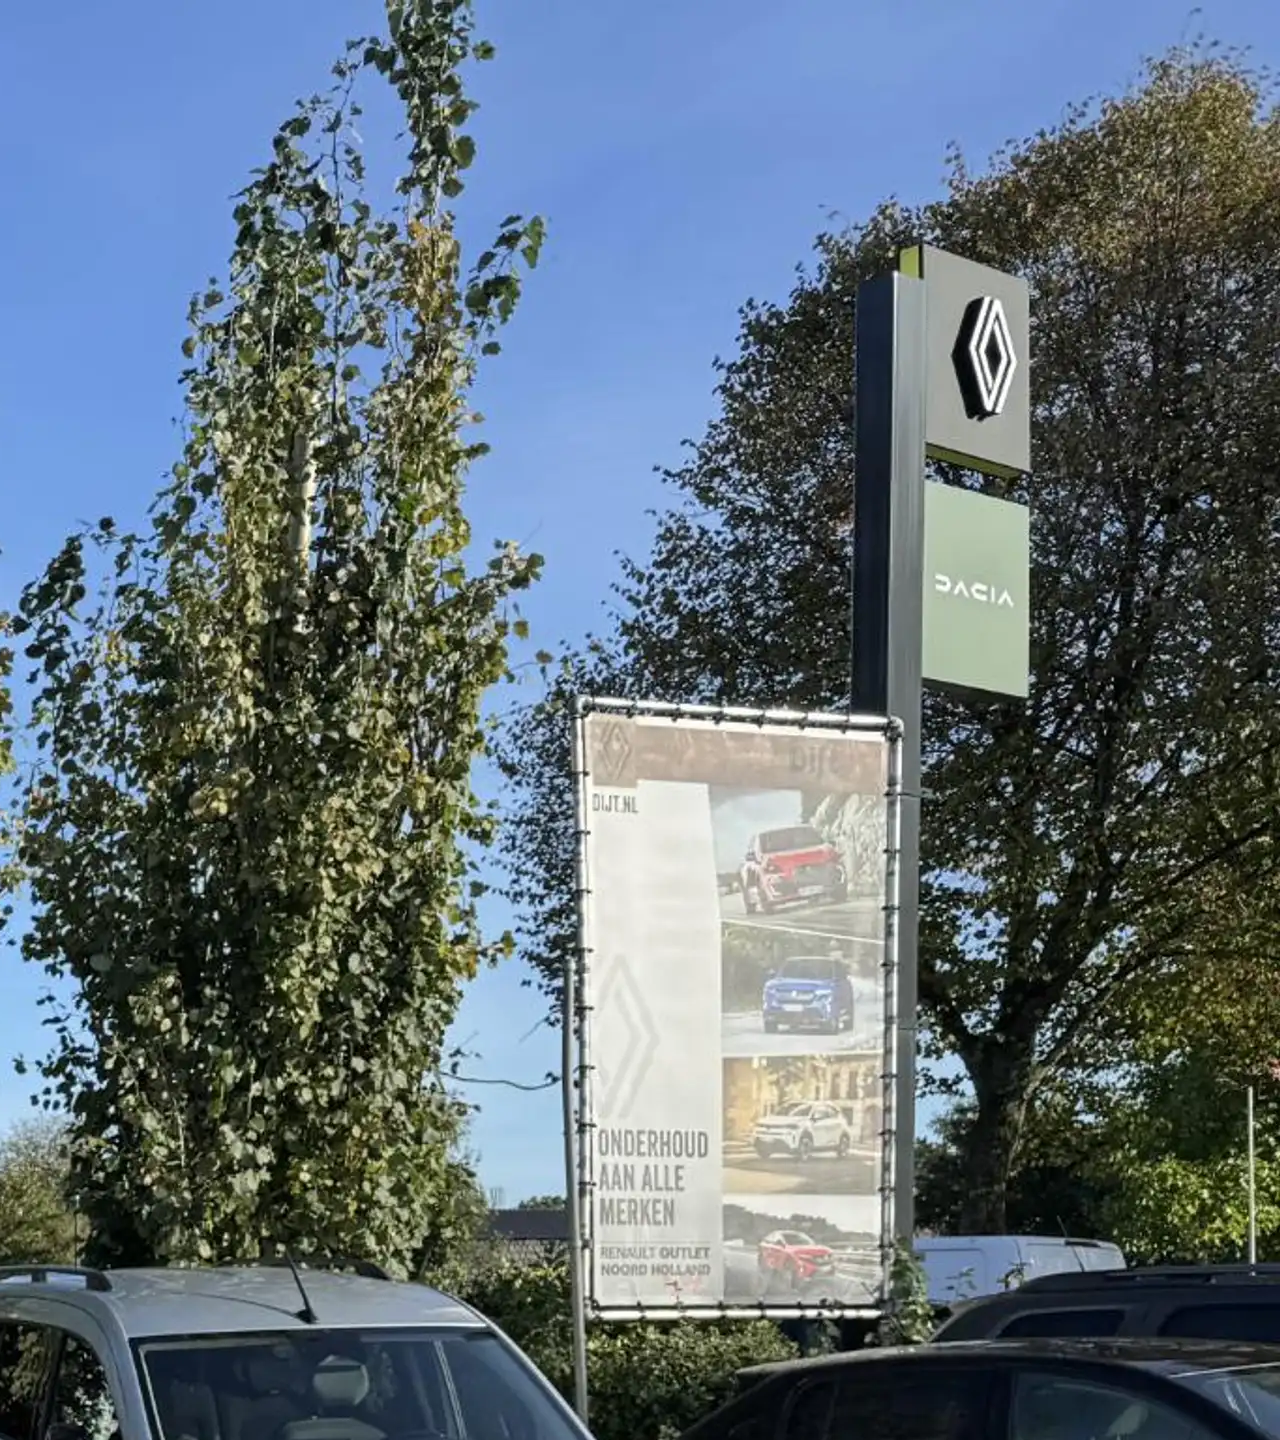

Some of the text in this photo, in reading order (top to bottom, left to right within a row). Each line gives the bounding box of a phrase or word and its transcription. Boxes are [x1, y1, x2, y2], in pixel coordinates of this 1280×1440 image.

[935, 573, 1015, 608] DACIA
[592, 793, 639, 814] DIJT.NL
[598, 1129, 709, 1158] ONDERHOUD
[599, 1163, 686, 1191] AAN ALLE
[599, 1198, 675, 1226] MERKEN
[599, 1246, 711, 1260] RENAULT OUTLET
[601, 1263, 711, 1276] NOORD HOLLAND
